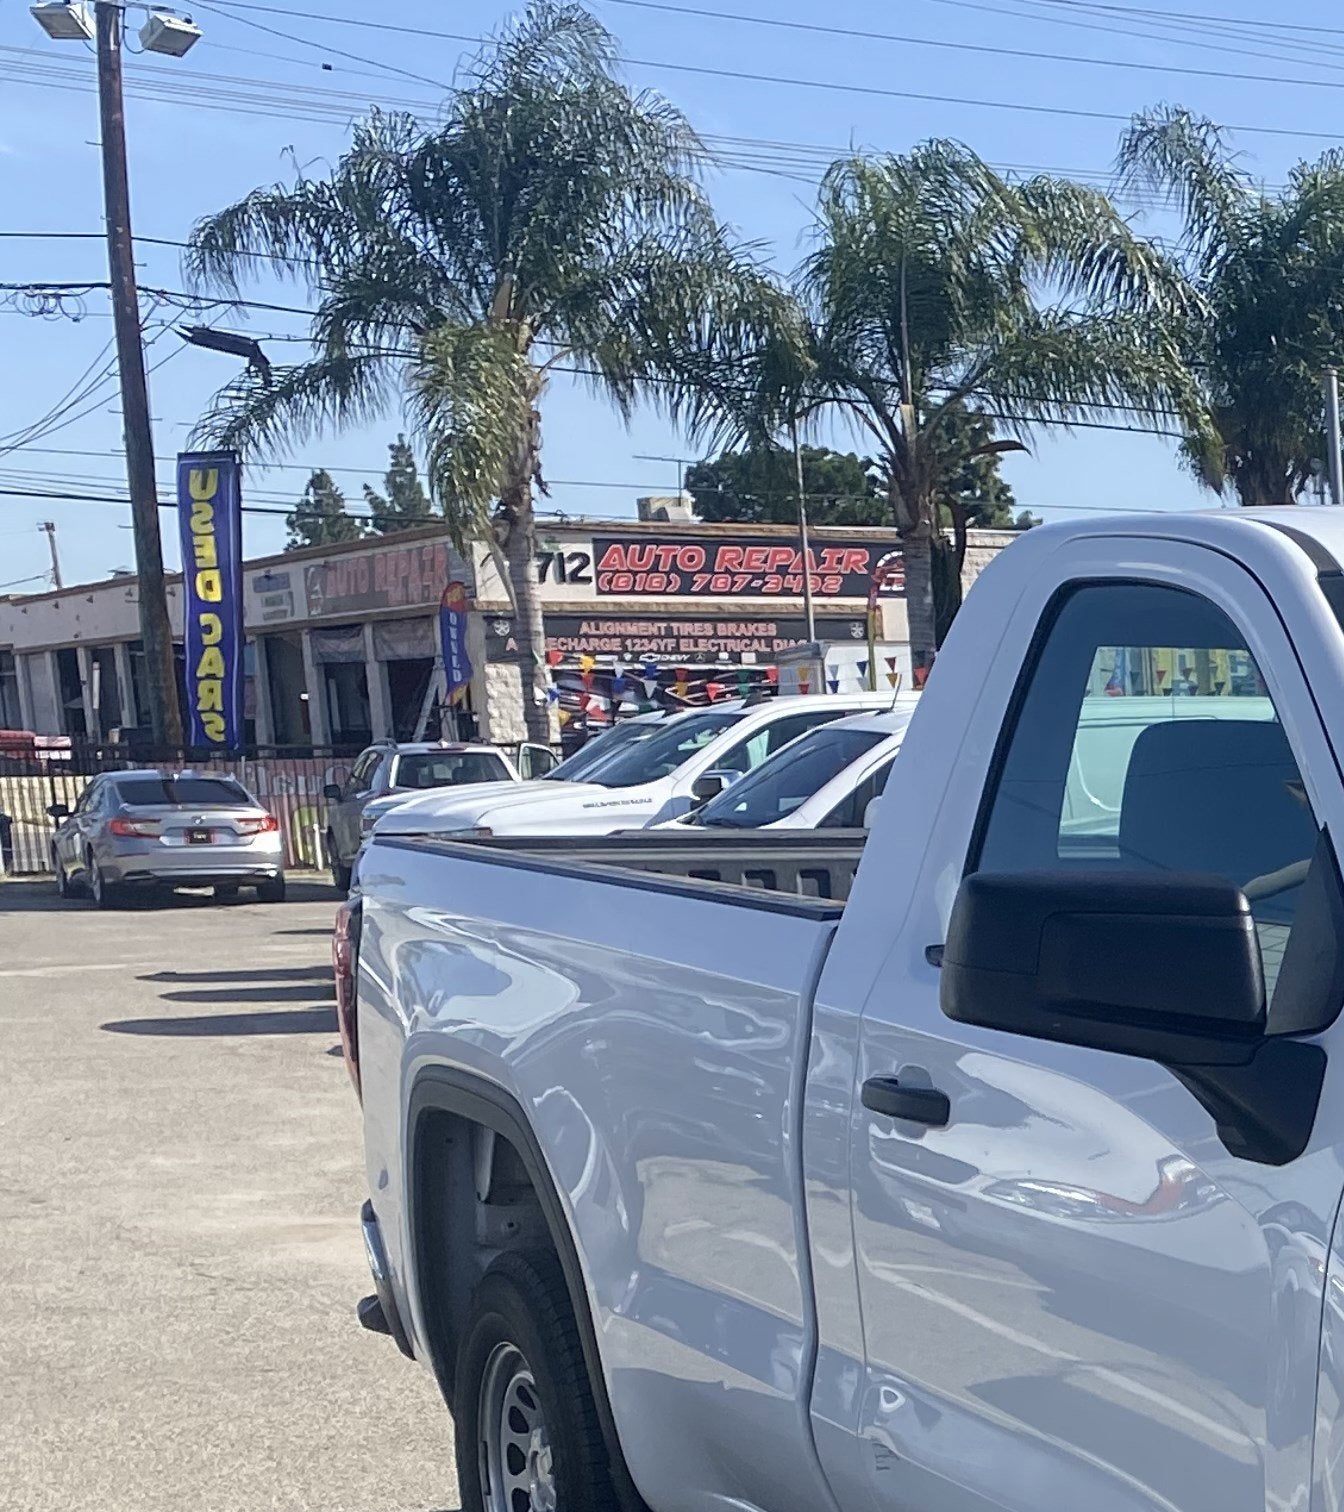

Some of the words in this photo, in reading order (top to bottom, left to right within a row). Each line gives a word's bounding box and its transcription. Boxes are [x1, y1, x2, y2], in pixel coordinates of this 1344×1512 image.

[534, 551, 593, 585] 712
[598, 543, 705, 572] AUTO
[714, 545, 871, 575] REPAIR
[598, 572, 682, 593] (818)
[579, 621, 668, 636] ALIGNMENT
[670, 621, 714, 636] TIRES
[717, 622, 777, 636] BRAKES
[625, 637, 677, 651] 1234YF
[680, 638, 772, 652] ELECTRICAL
